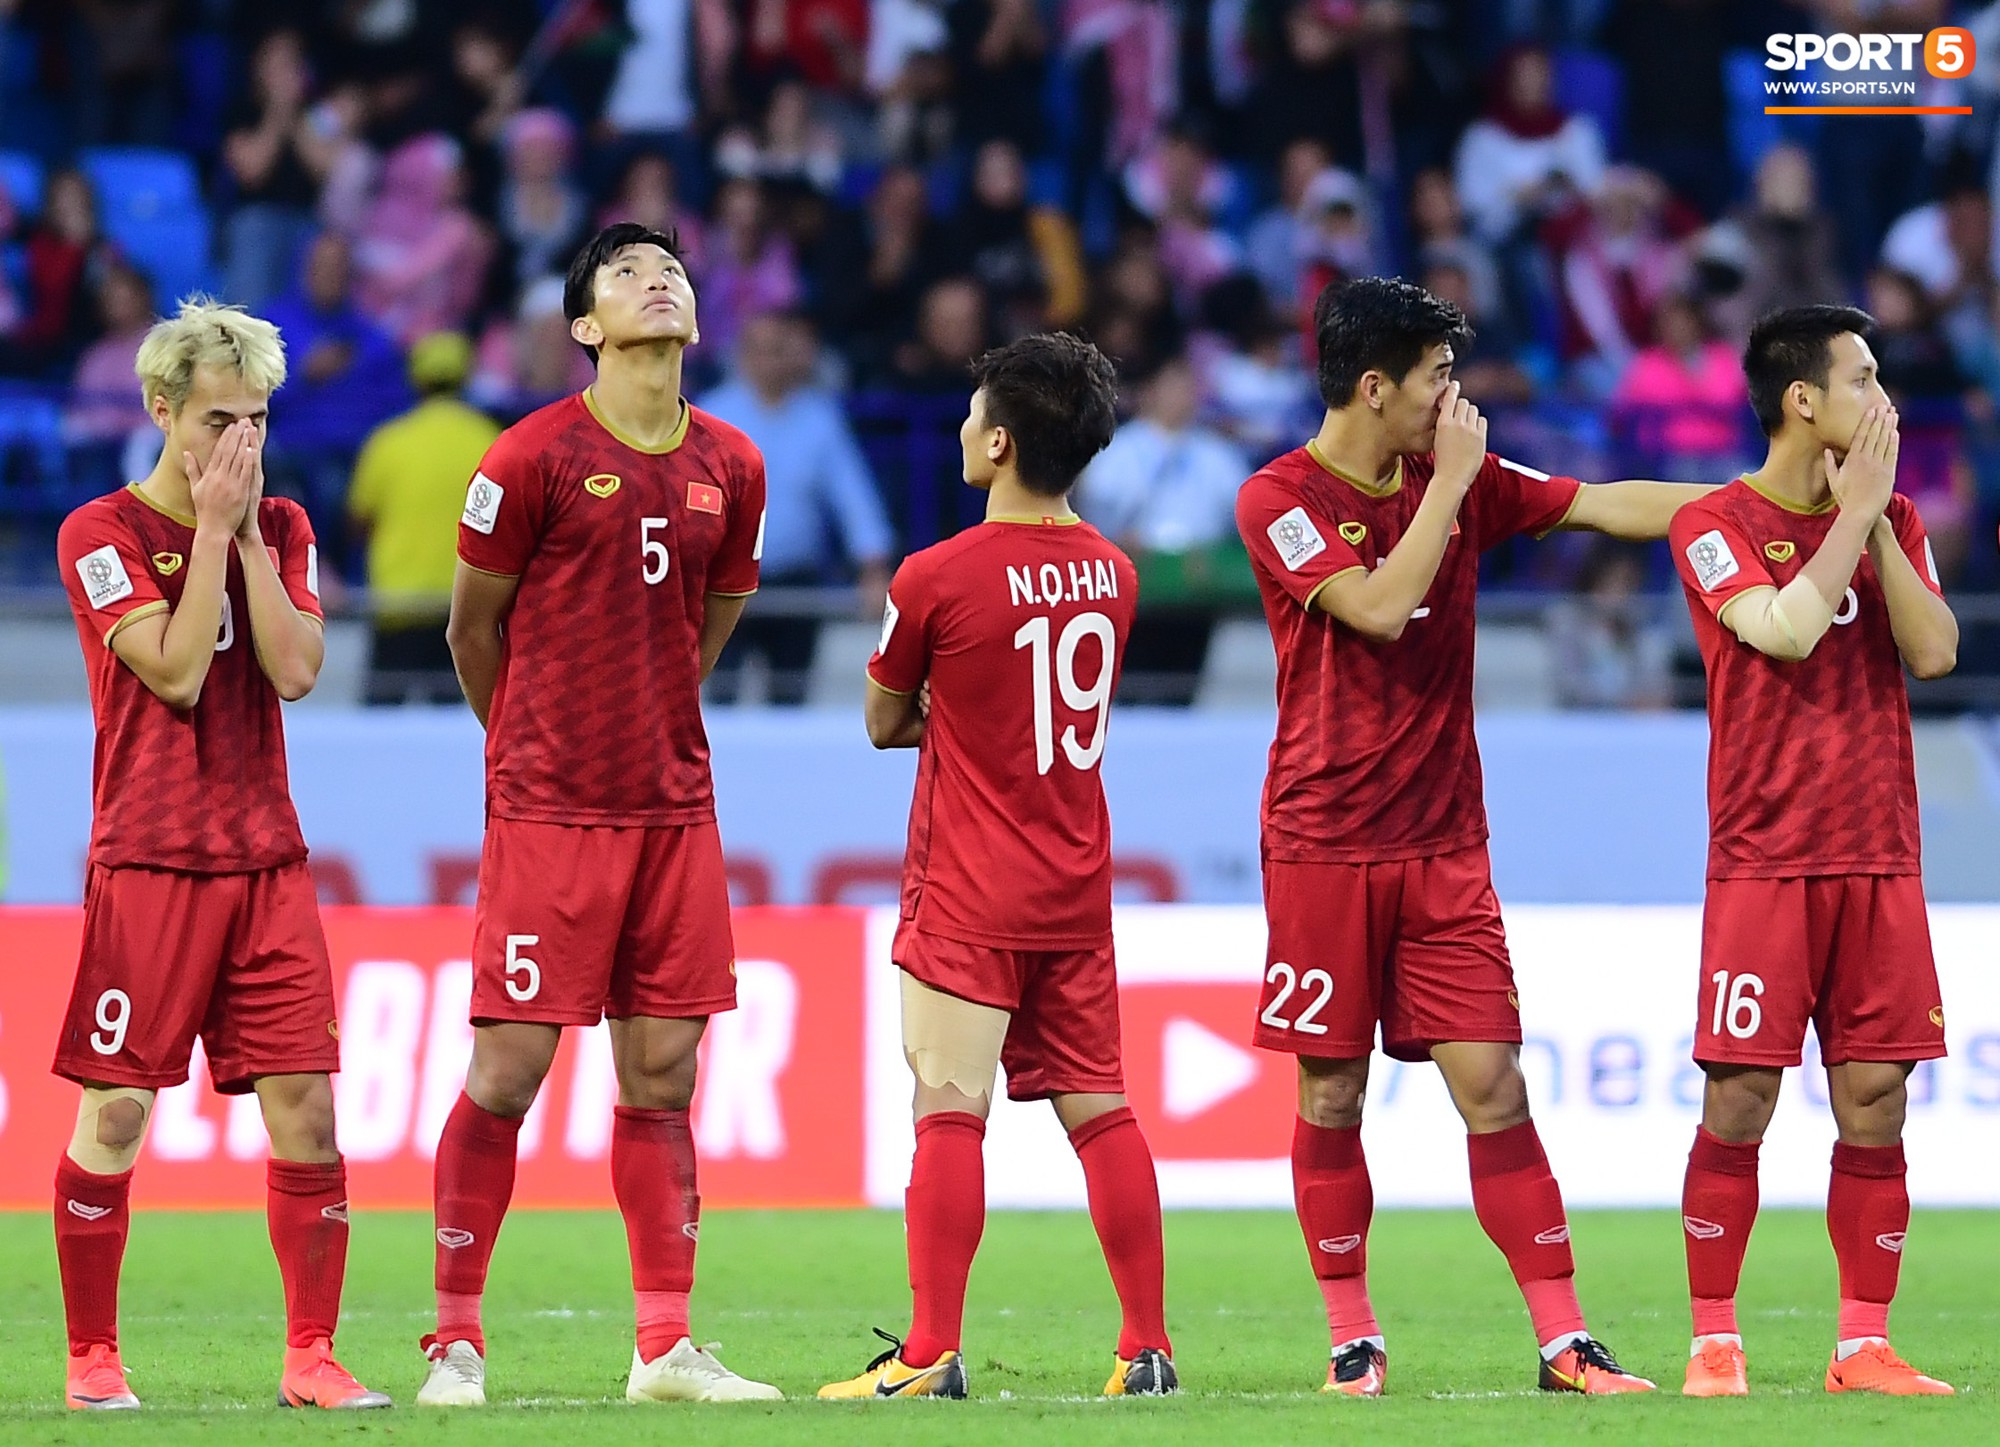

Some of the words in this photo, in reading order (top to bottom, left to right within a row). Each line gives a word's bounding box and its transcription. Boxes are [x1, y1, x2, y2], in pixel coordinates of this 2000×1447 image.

[640, 517, 669, 585] 5
[1006, 559, 1118, 608] N.Q.HAI
[1014, 611, 1116, 775] 19
[505, 935, 540, 1001] 5
[1261, 962, 1333, 1035] 22
[90, 988, 131, 1055] 9
[1712, 969, 1765, 1039] 16
